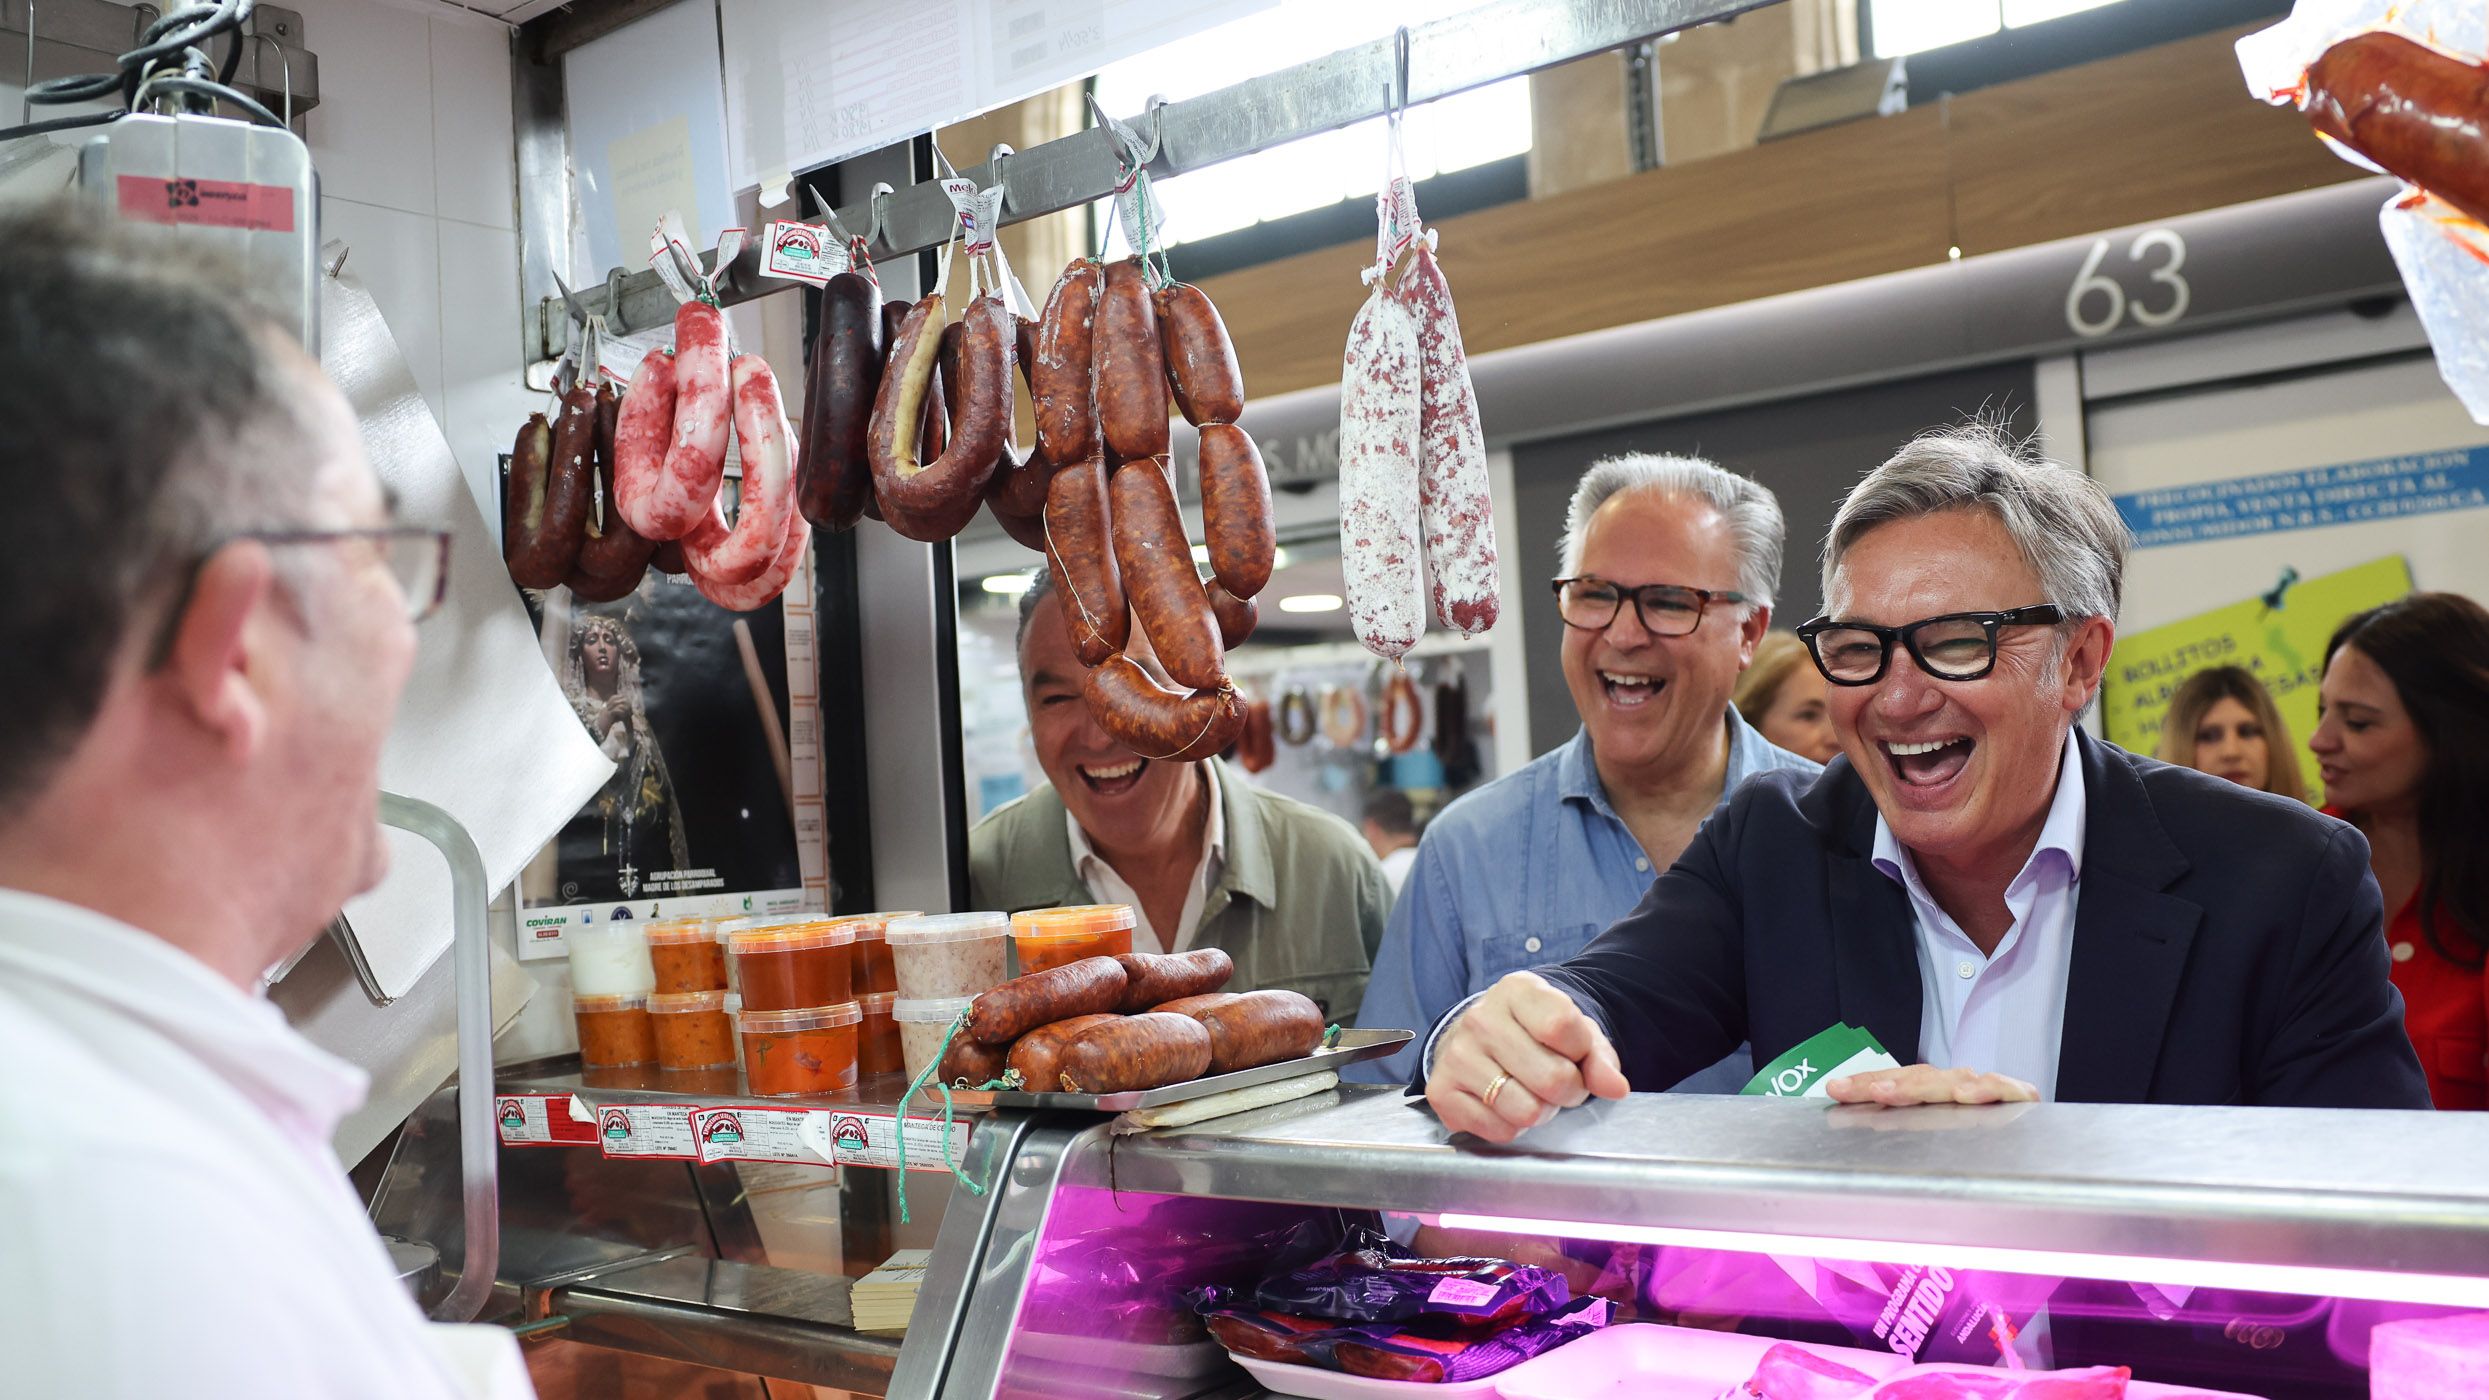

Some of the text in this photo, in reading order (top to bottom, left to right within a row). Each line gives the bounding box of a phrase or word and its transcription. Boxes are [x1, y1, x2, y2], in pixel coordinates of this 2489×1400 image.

[2066, 229, 2190, 337] 63
[1765, 1058, 1818, 1097] VOX
[1880, 1270, 1918, 1325] PROGRAMA
[1889, 1265, 1954, 1361] SENTIDO
[1873, 1320, 1889, 1339] UN
